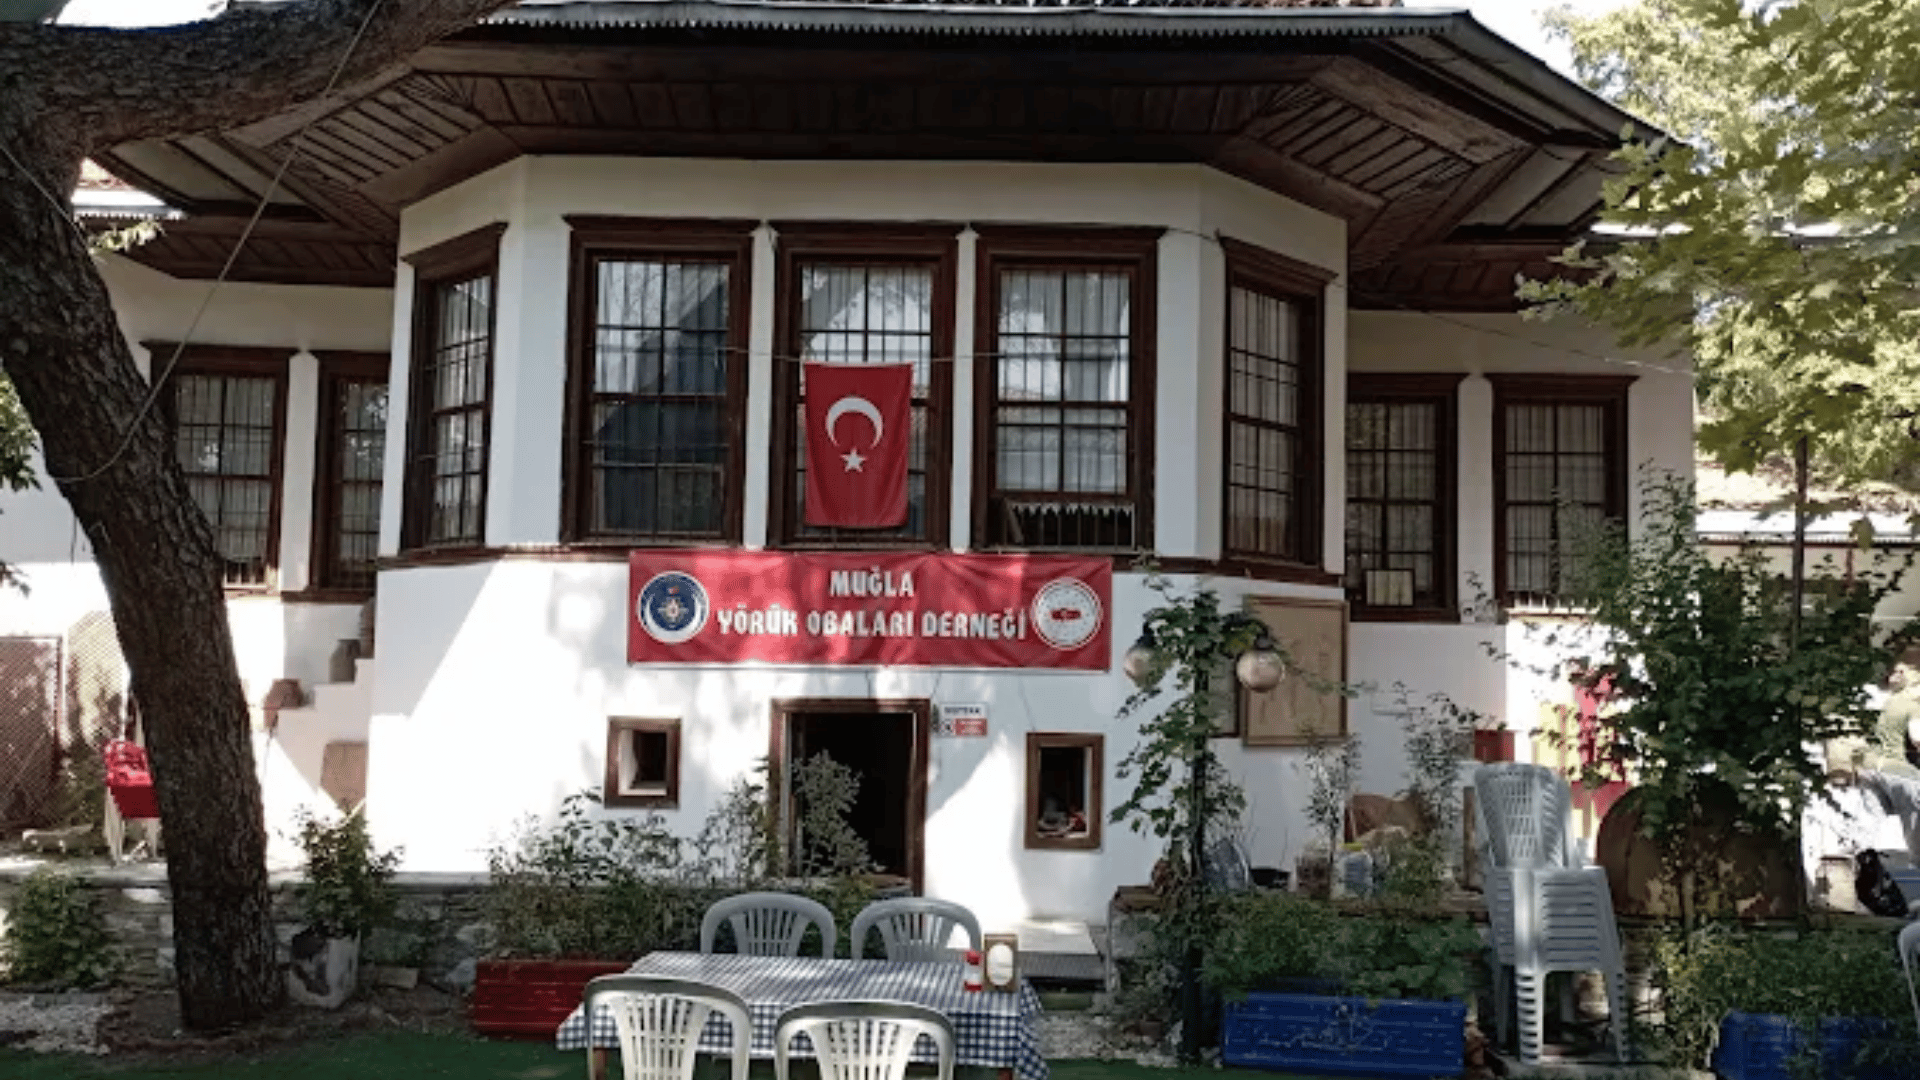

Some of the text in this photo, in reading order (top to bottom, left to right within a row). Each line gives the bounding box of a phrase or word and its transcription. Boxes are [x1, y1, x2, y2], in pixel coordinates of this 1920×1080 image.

[830, 565, 914, 597] MUĞLA
[717, 602, 798, 636] YÖRÜK
[807, 609, 914, 637] OBALARI
[921, 607, 1026, 640] DERNEĞİ
